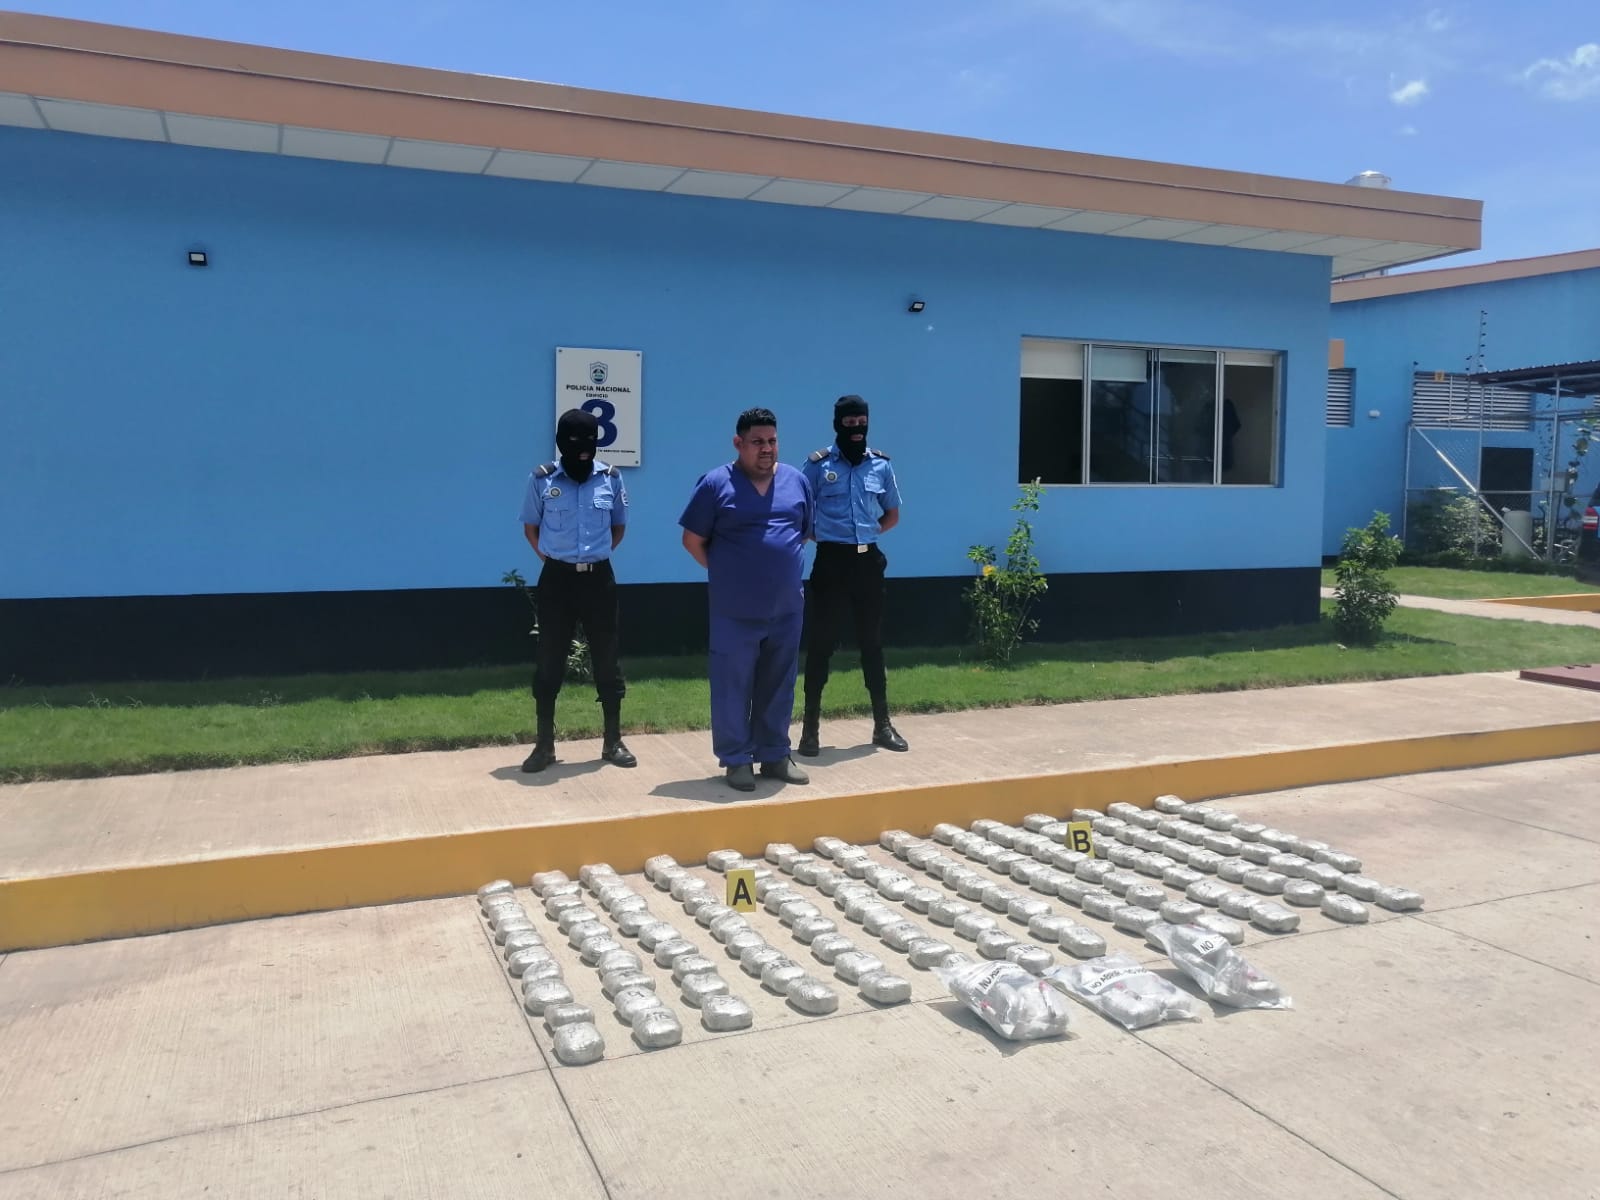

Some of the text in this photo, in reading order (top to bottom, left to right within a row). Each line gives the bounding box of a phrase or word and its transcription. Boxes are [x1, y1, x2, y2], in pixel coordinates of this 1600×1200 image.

[580, 399, 618, 447] 8
[1073, 830, 1091, 853] B
[732, 878, 753, 906] A
[1200, 940, 1214, 952] NO
